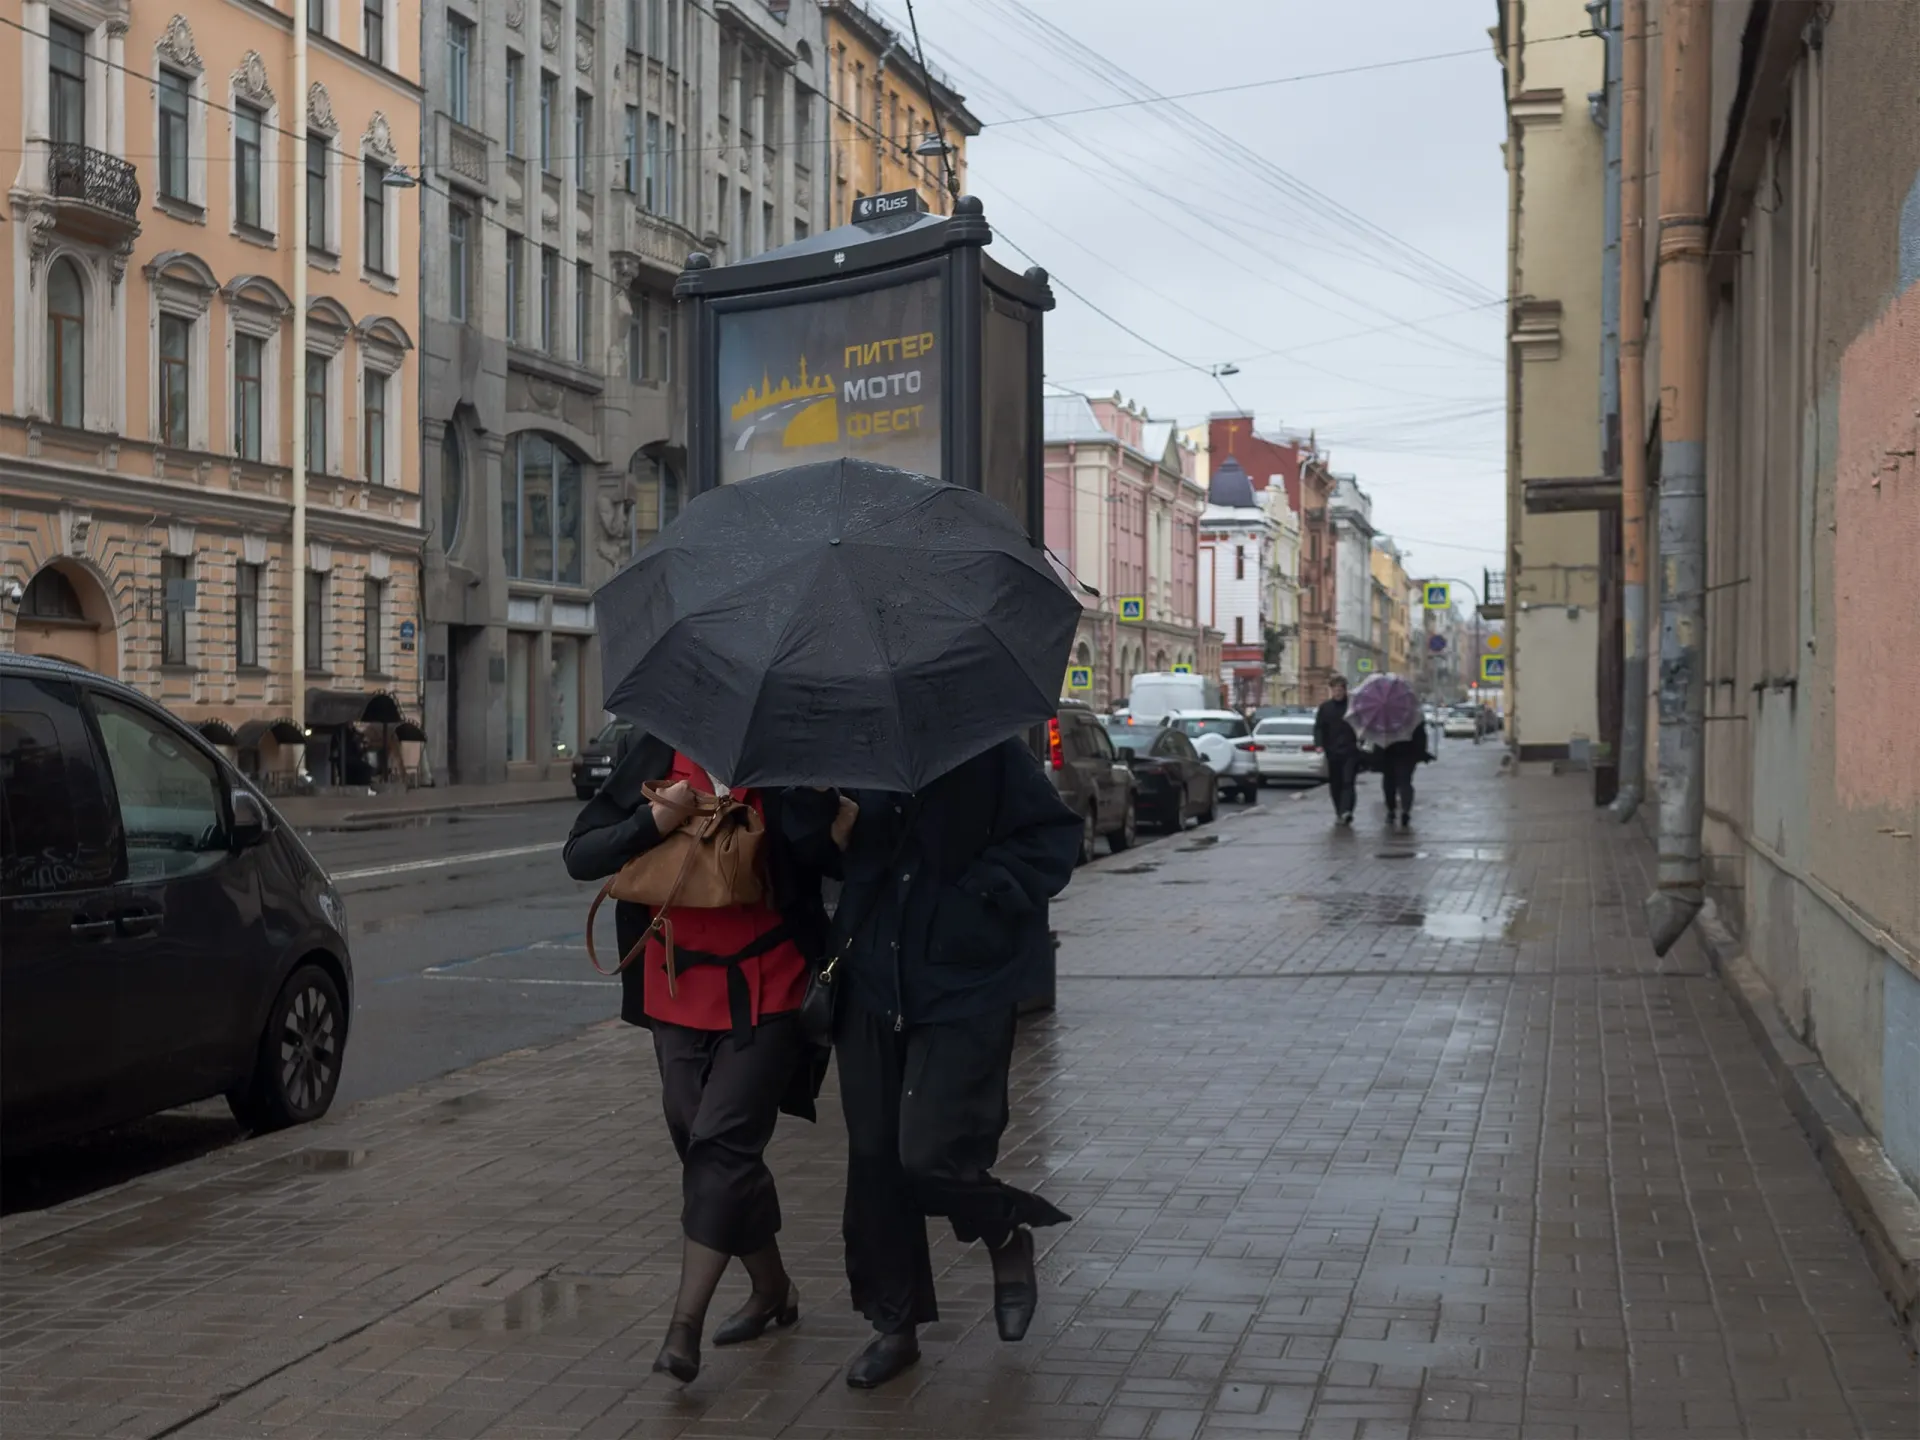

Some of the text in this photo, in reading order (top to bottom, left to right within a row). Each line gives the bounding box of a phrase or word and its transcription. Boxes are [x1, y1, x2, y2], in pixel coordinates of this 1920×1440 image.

[876, 196, 908, 213] Russ
[844, 332, 935, 368] ПИТЕР
[843, 370, 922, 403] МОТО
[846, 404, 925, 439] ФЕСТ
